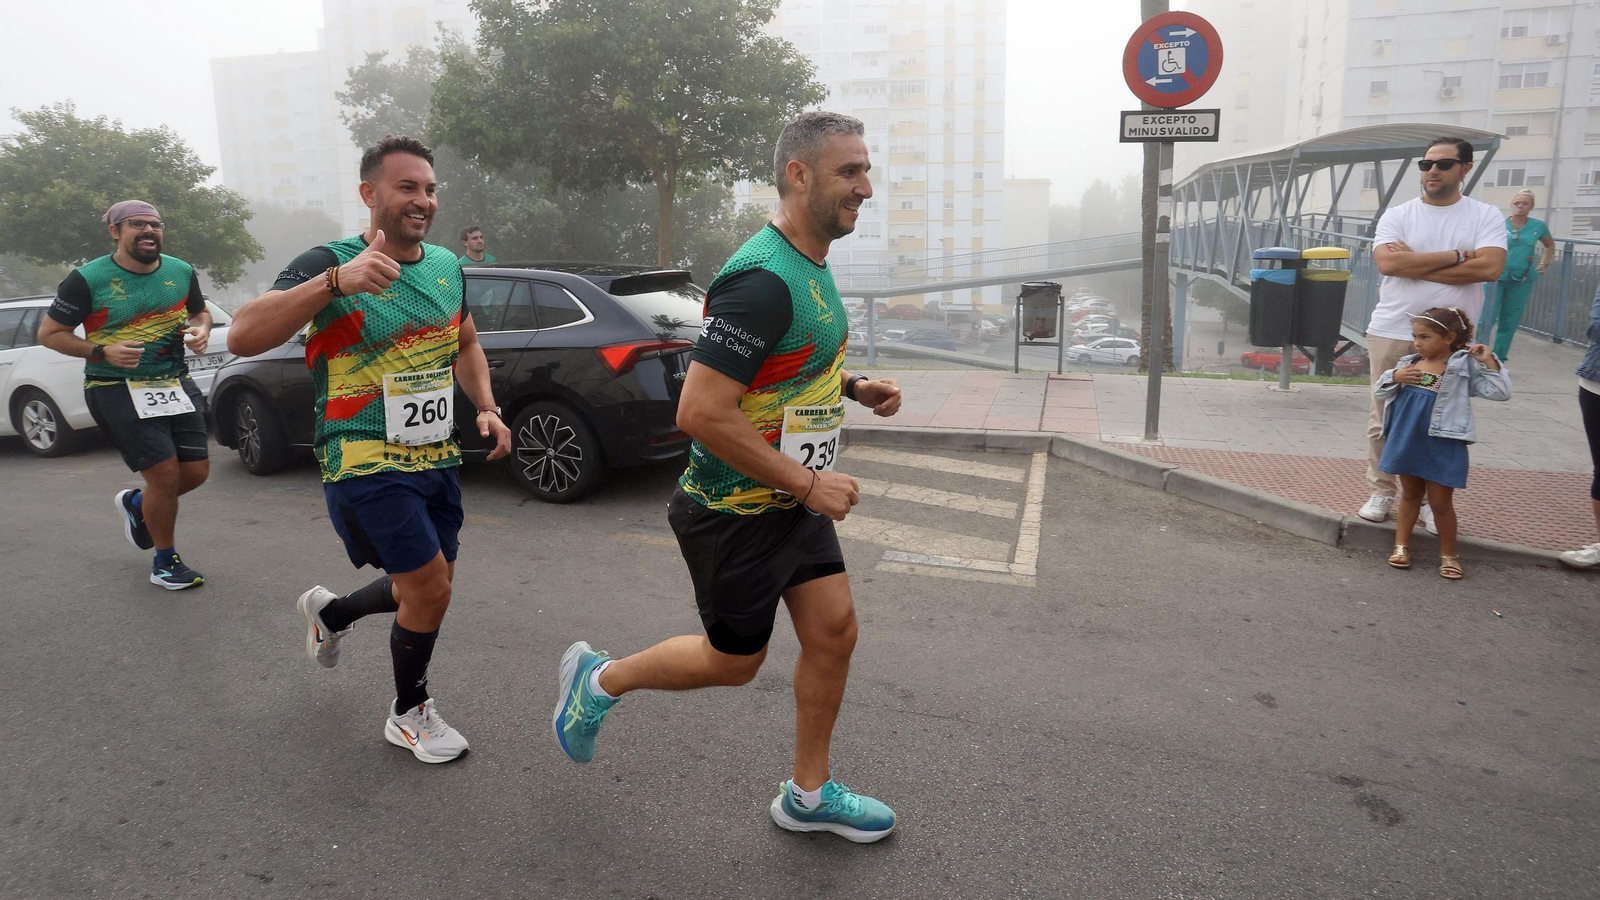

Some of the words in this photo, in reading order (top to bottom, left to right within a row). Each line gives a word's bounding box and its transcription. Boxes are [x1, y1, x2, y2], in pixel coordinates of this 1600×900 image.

[1154, 40, 1190, 50] EXCEPTO
[1142, 115, 1196, 125] EXCEPTO
[1128, 126, 1209, 136] MINUSVALIDO
[715, 318, 766, 349] Diputación
[710, 331, 723, 343] de
[725, 337, 753, 359] Cádiz
[394, 374, 424, 383] CARRERA
[144, 391, 181, 406] 334
[403, 396, 447, 427] 260
[795, 408, 828, 416] CARRERA
[800, 437, 836, 470] 239
